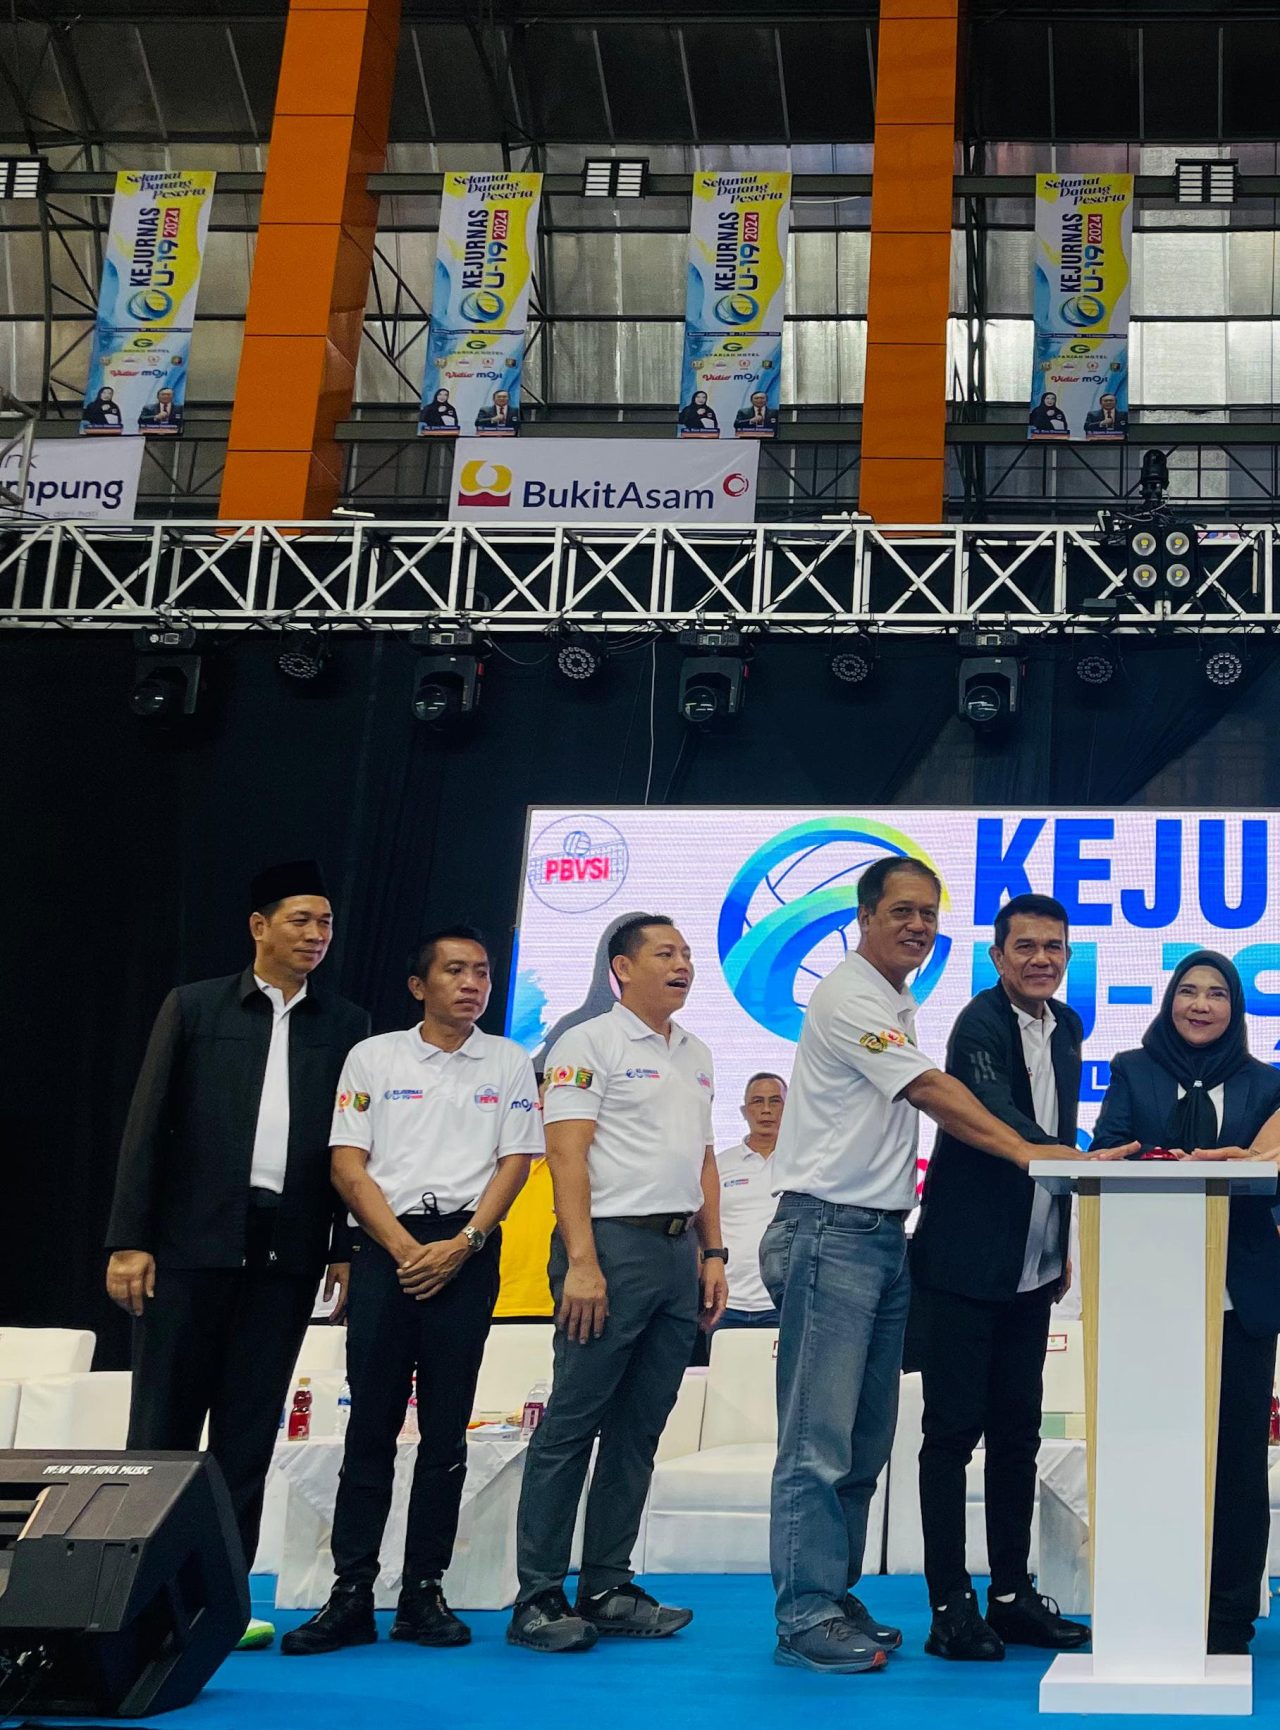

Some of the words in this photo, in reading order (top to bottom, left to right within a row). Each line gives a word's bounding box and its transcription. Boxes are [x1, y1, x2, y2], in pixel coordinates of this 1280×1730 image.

[126, 172, 181, 184] Selamat
[140, 178, 193, 191] Datang
[453, 174, 508, 185] Selamat
[467, 181, 520, 193] Datang
[702, 175, 758, 187] Selamat
[717, 182, 770, 196] Datang
[1044, 177, 1100, 189] Selamat
[1060, 184, 1111, 197] Datang
[153, 188, 206, 200] Peserta
[481, 191, 533, 201] Peserta
[730, 192, 783, 204] Peserta
[1073, 194, 1125, 205] Peserta
[164, 209, 180, 237] 2024
[493, 211, 508, 238] 2024
[745, 214, 759, 240] 2024
[1089, 215, 1102, 242] 2024
[130, 208, 160, 287] KEJURNAS
[462, 209, 489, 289] KEJURNAS
[715, 212, 740, 291] KEJURNAS
[1060, 213, 1083, 292] KEJURNAS
[153, 240, 178, 286] U-19
[484, 241, 508, 289] U-19
[738, 243, 760, 290] U-19
[1084, 245, 1104, 292] U-19
[523, 480, 714, 509] BukitAsam
[545, 857, 610, 882] PBVSI
[118, 1466, 153, 1475] MUSIC
